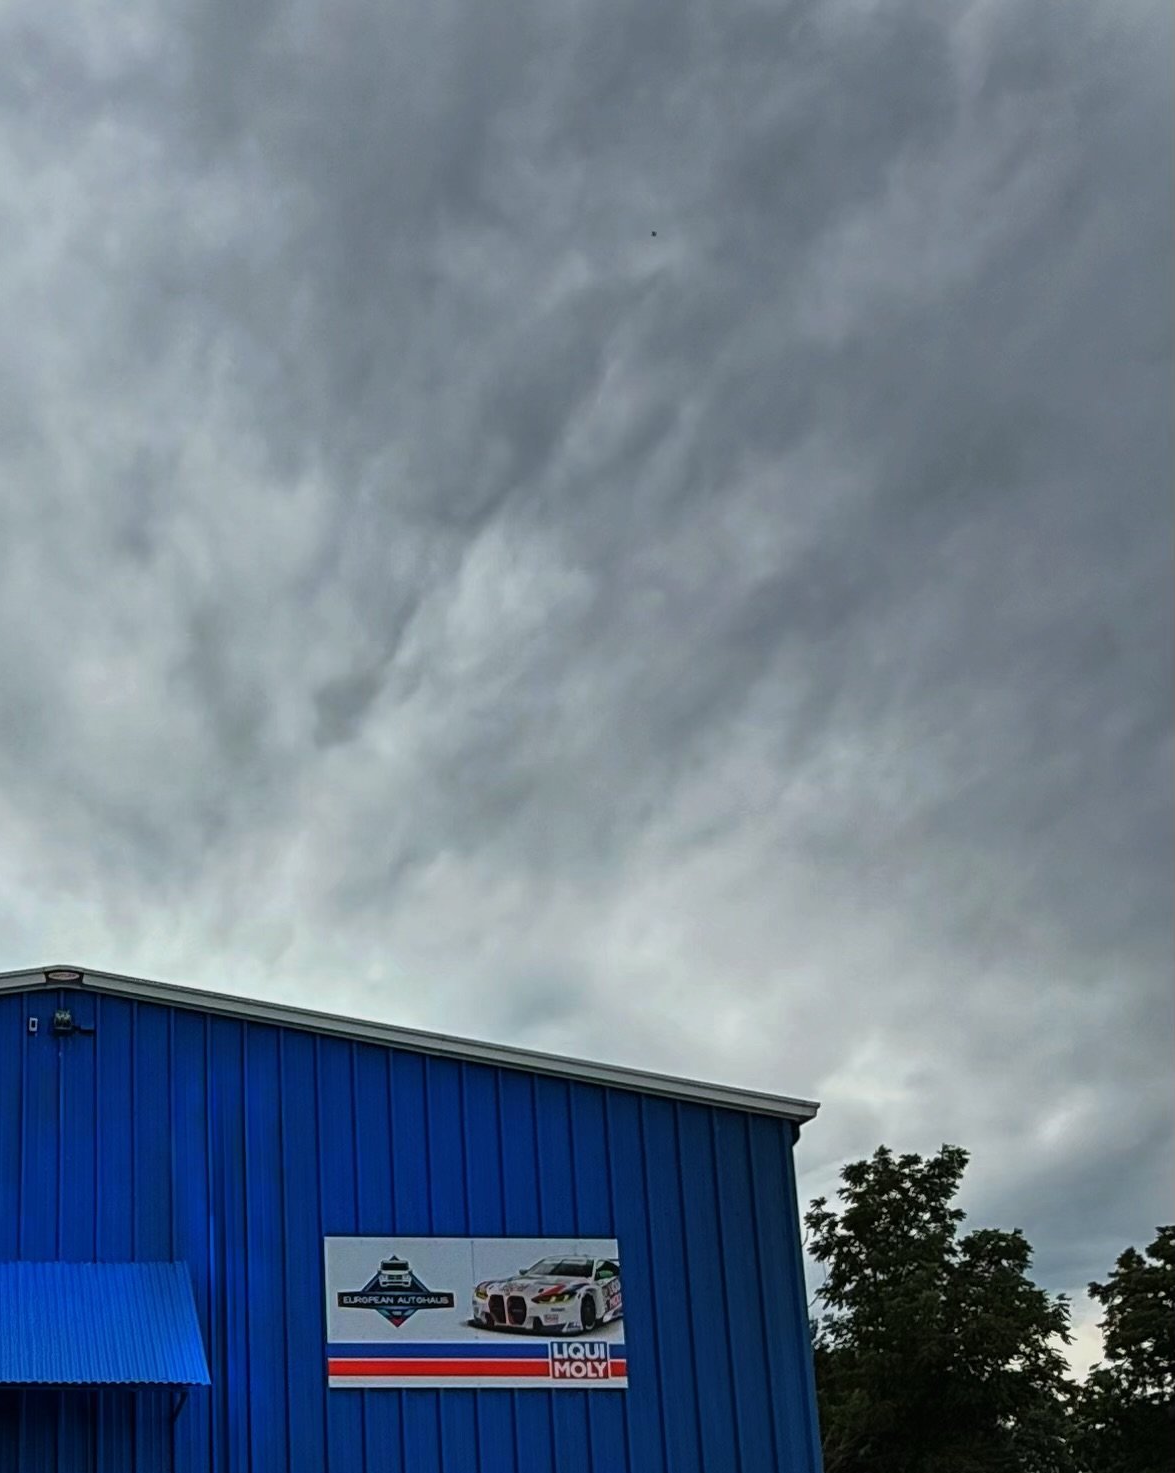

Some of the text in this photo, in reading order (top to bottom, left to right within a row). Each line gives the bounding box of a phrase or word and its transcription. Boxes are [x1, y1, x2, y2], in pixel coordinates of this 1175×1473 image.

[343, 1296, 449, 1304] EUROPEAN AUTOHAUS
[552, 1343, 605, 1360] LIQUI
[554, 1361, 607, 1378] MOLY
